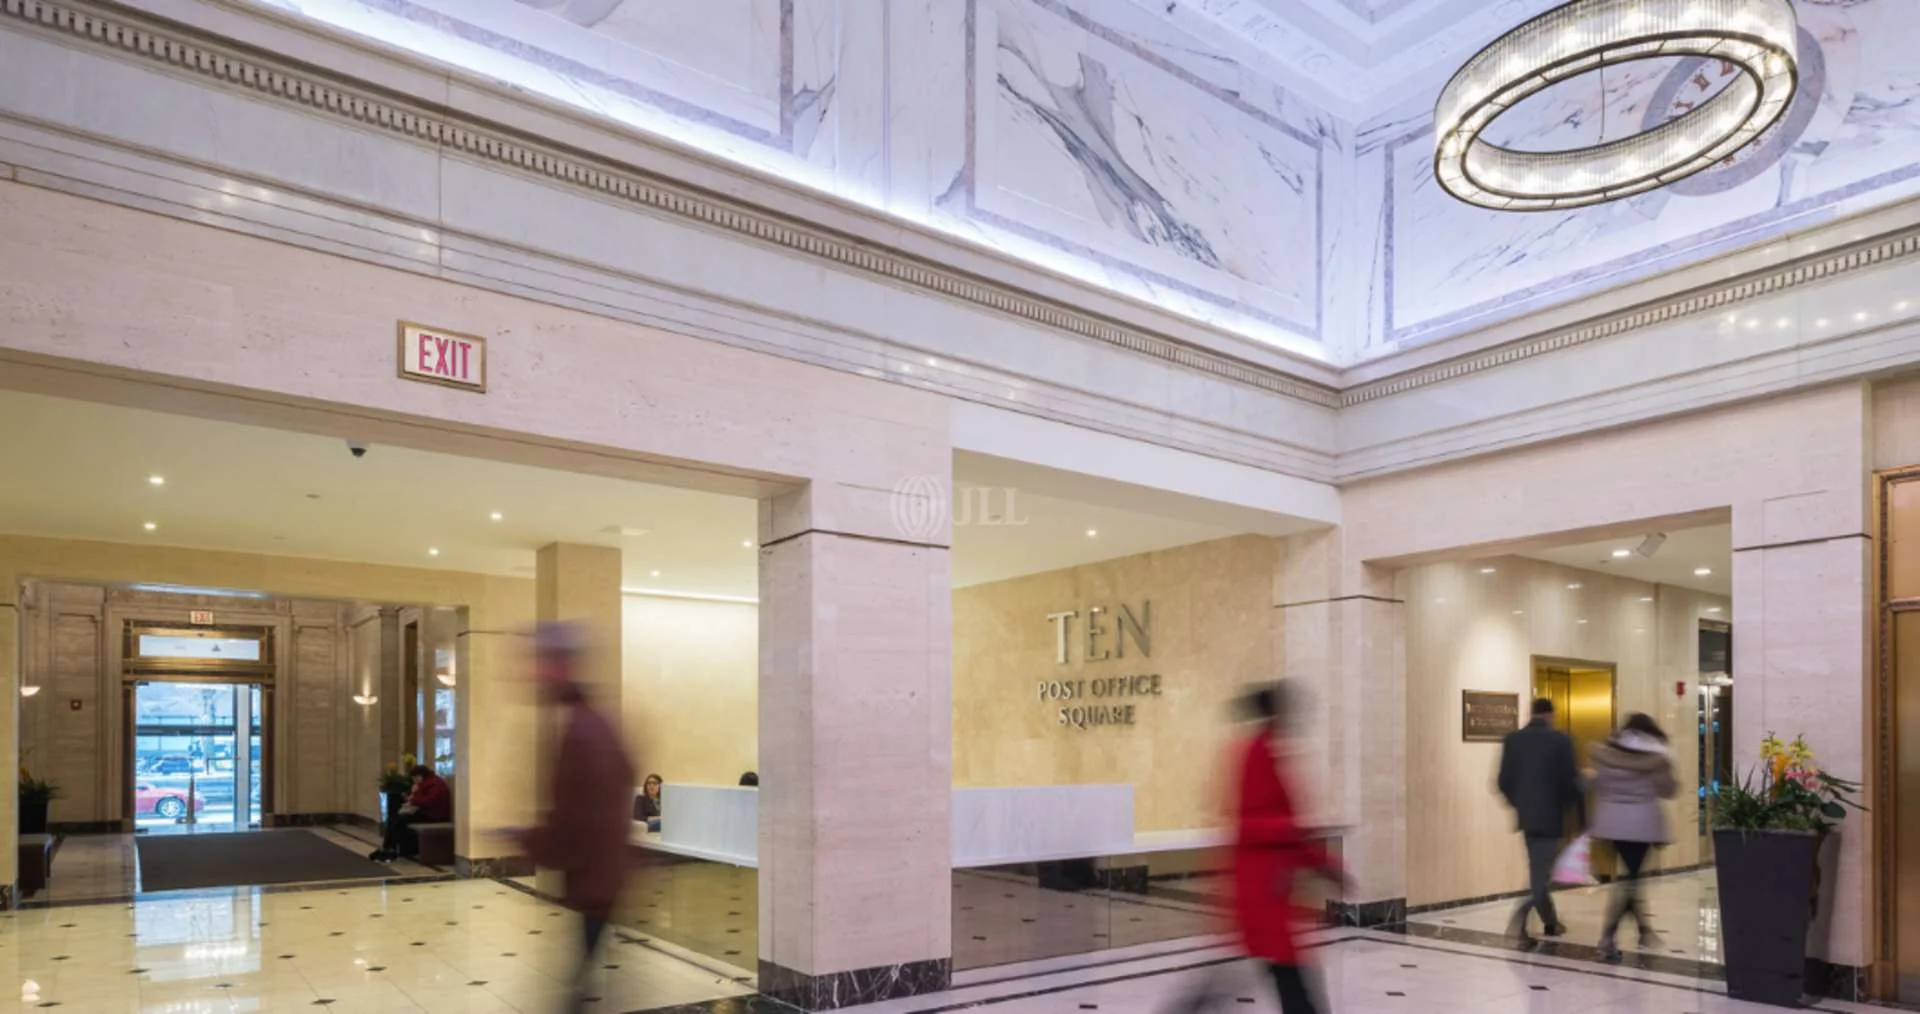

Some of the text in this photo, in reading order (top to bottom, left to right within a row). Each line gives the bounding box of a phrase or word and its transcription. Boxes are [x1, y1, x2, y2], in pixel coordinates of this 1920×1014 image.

[418, 333, 473, 379] EXIT
[1047, 599, 1151, 664] TEN
[1038, 674, 1162, 702] POST OFFICE
[1059, 704, 1136, 730] SQUARE
